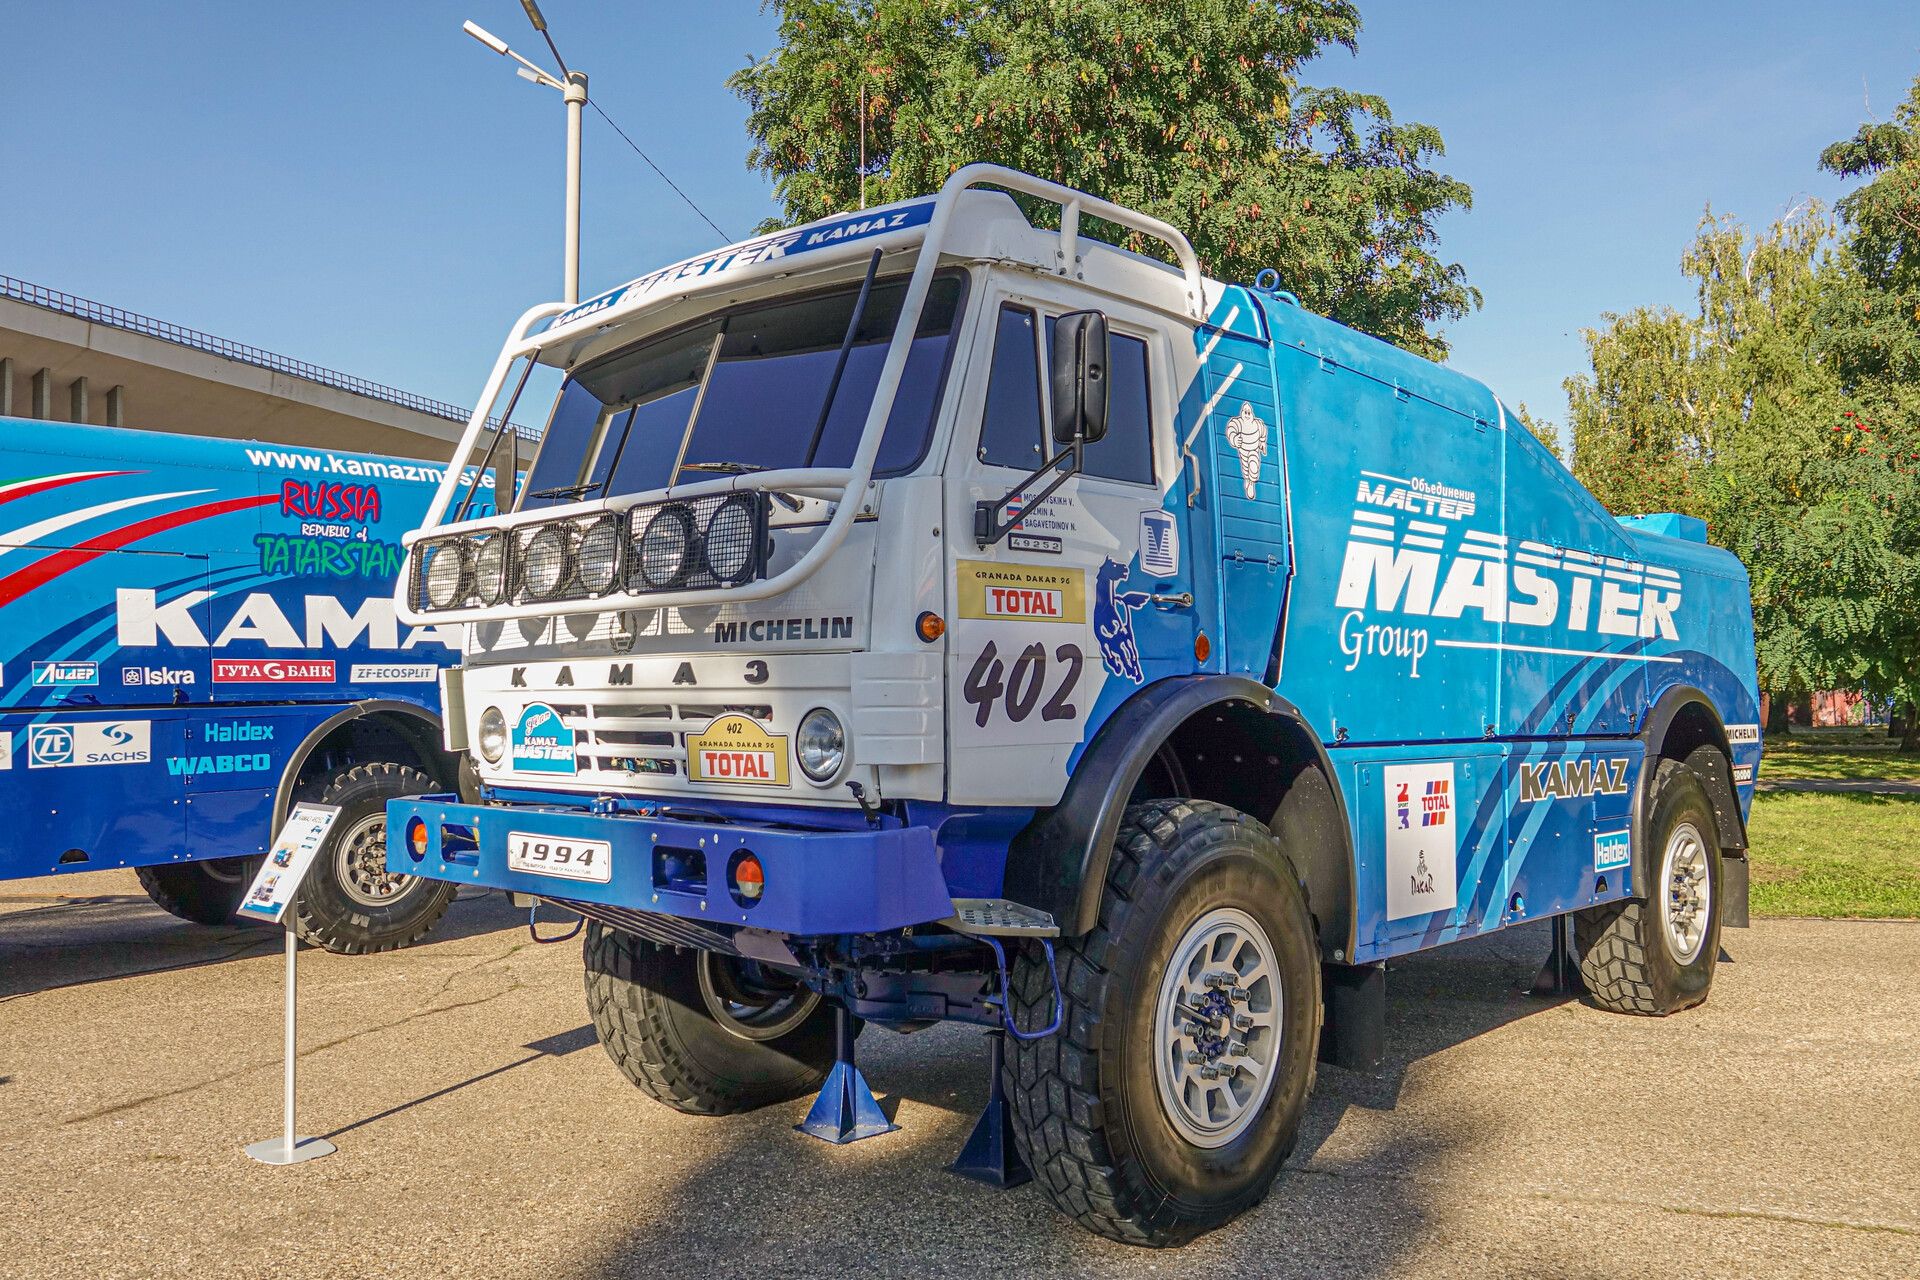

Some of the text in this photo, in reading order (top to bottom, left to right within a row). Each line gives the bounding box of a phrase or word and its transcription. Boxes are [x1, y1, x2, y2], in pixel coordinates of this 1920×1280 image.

[807, 213, 909, 246] KAMAZ
[282, 480, 379, 521] RUSSIA
[1356, 480, 1476, 520] МАСТЕР
[1411, 477, 1476, 502] Объединение
[302, 524, 368, 542] REPUBLIC of
[1013, 538, 1059, 550] 49252
[257, 535, 405, 577] TATARSTAN
[975, 571, 1022, 581] GRANADA
[1026, 575, 1057, 584] DAKAR
[1335, 510, 1682, 641] MASTER
[992, 589, 1056, 615] TOTAL
[714, 616, 853, 643] MICHELIN
[1339, 610, 1428, 679] Group
[144, 667, 195, 685] Iskra
[217, 665, 261, 677] ГУТА
[287, 665, 331, 677] БАНК
[964, 640, 1083, 728] 402
[205, 720, 274, 742] Haldex
[726, 722, 742, 734] 402
[1726, 728, 1757, 739] MICHELIN
[35, 733, 71, 757] ZF
[513, 745, 574, 760] MASTER
[524, 737, 558, 746] KAMAZ
[86, 751, 148, 763] SACHS
[166, 753, 271, 776] WABCO
[705, 752, 769, 778] TOTAL
[1520, 758, 1630, 802] KAMAZ
[1421, 794, 1450, 811] TOTAL
[520, 841, 595, 867] 1994
[1597, 838, 1628, 866] Haldex
